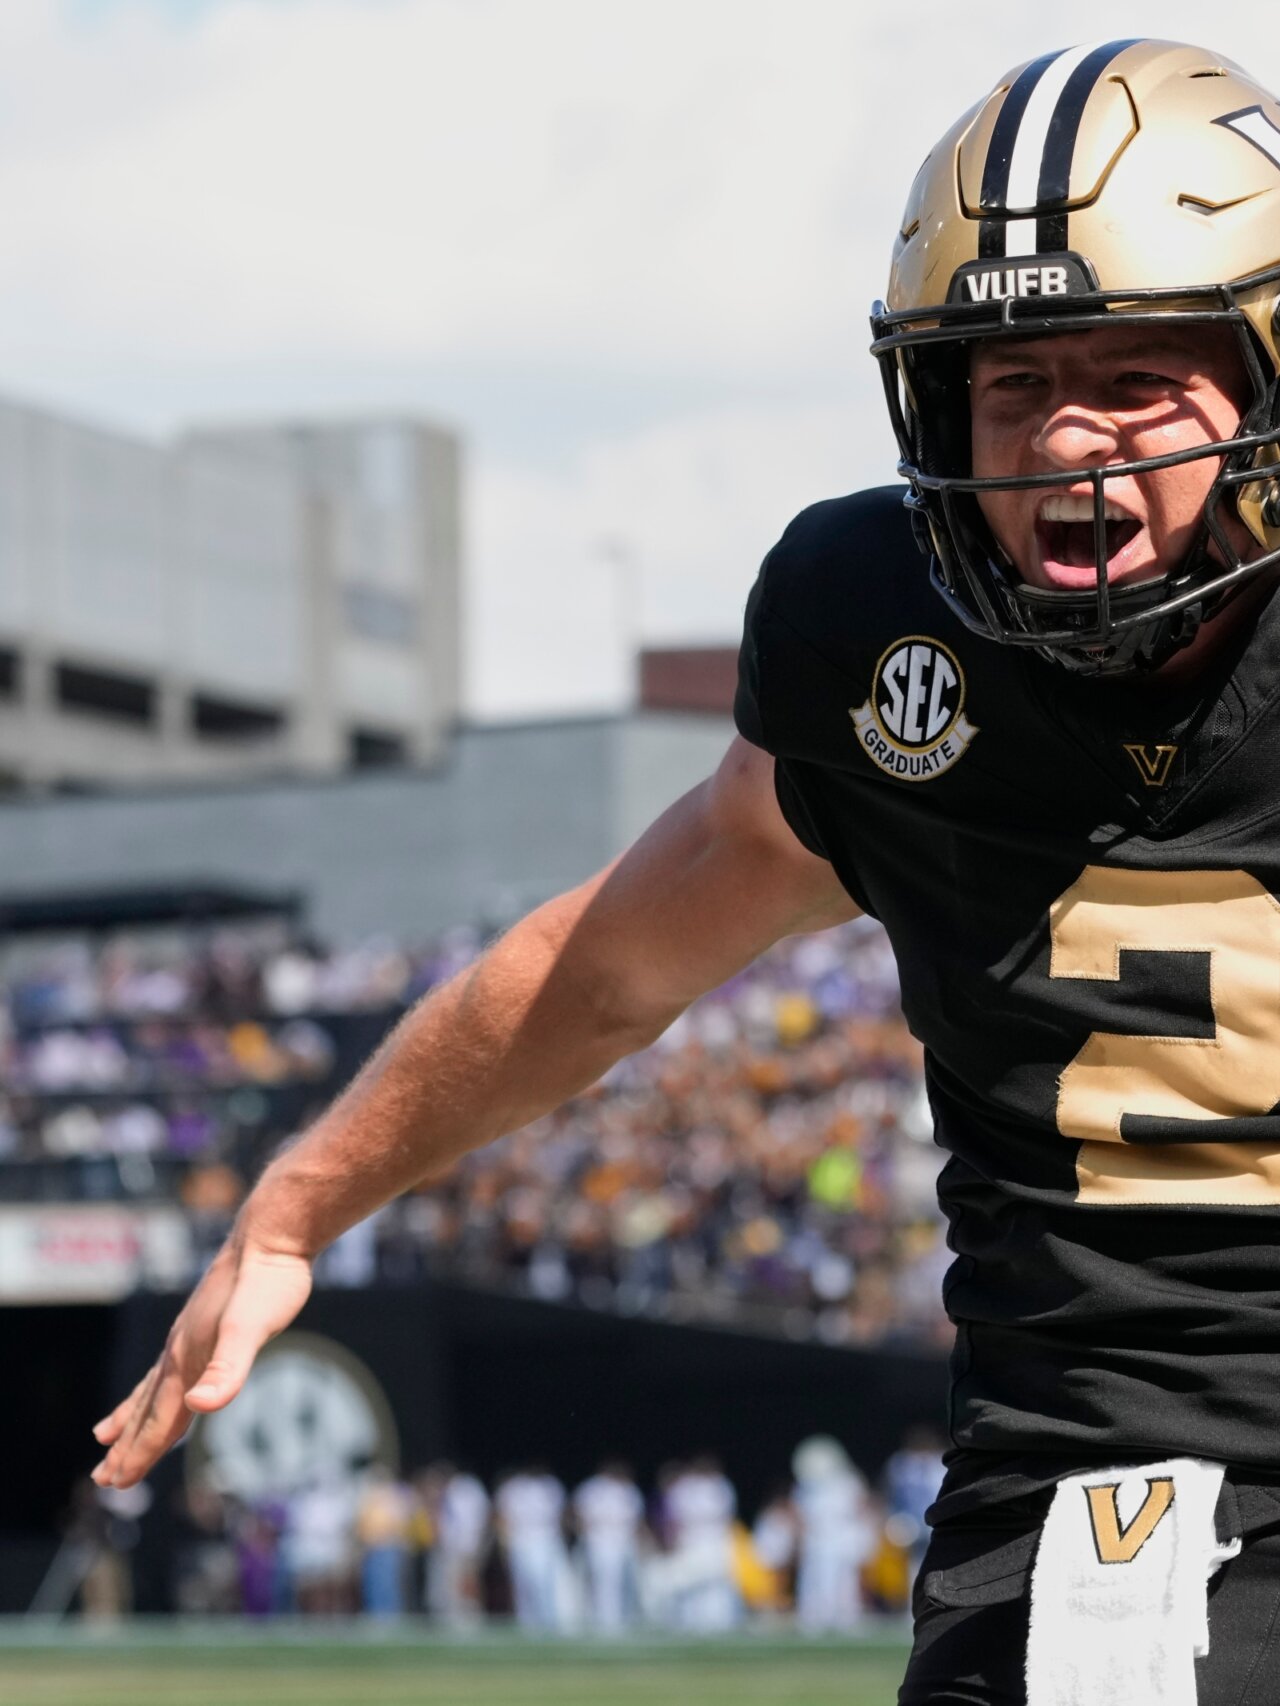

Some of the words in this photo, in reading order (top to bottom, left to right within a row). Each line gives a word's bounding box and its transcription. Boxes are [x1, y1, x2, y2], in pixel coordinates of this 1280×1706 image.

[966, 266, 1068, 302] VUFB
[879, 644, 958, 743] SEC
[864, 728, 956, 776] GRADUATE
[1122, 743, 1179, 787] V
[1081, 1475, 1177, 1565] V
